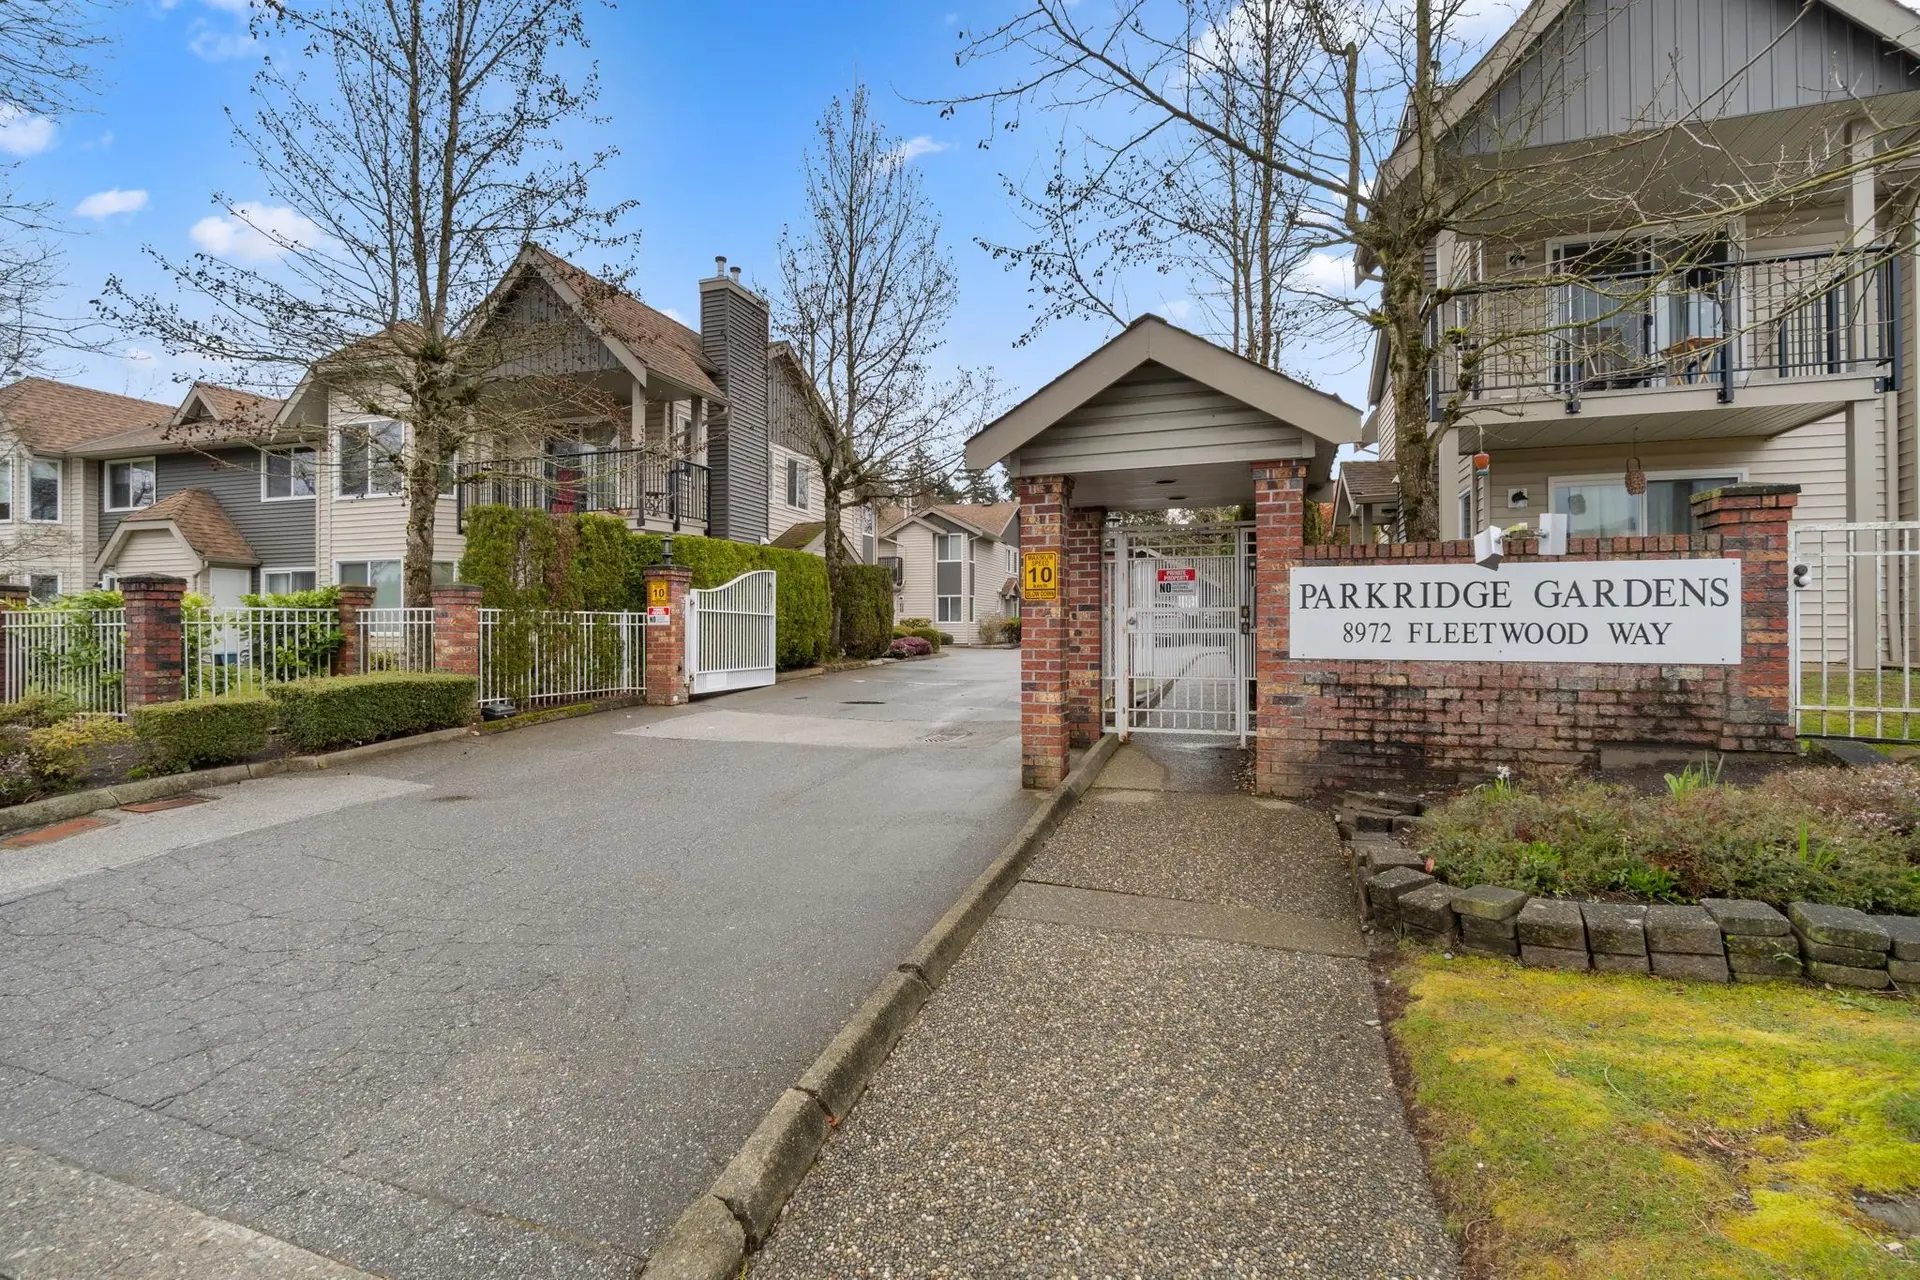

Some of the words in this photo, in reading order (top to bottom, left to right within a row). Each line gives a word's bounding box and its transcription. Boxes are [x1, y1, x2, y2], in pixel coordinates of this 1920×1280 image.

[1028, 566, 1053, 583] 10
[653, 588, 665, 598] 10
[1160, 582, 1172, 593] NO
[1298, 580, 1513, 610] PARKRIDGE
[1533, 577, 1730, 608] GARDENS
[1342, 621, 1393, 644] 8972
[1407, 621, 1589, 645] FLEETWOOD
[1606, 621, 1673, 645] WAY
